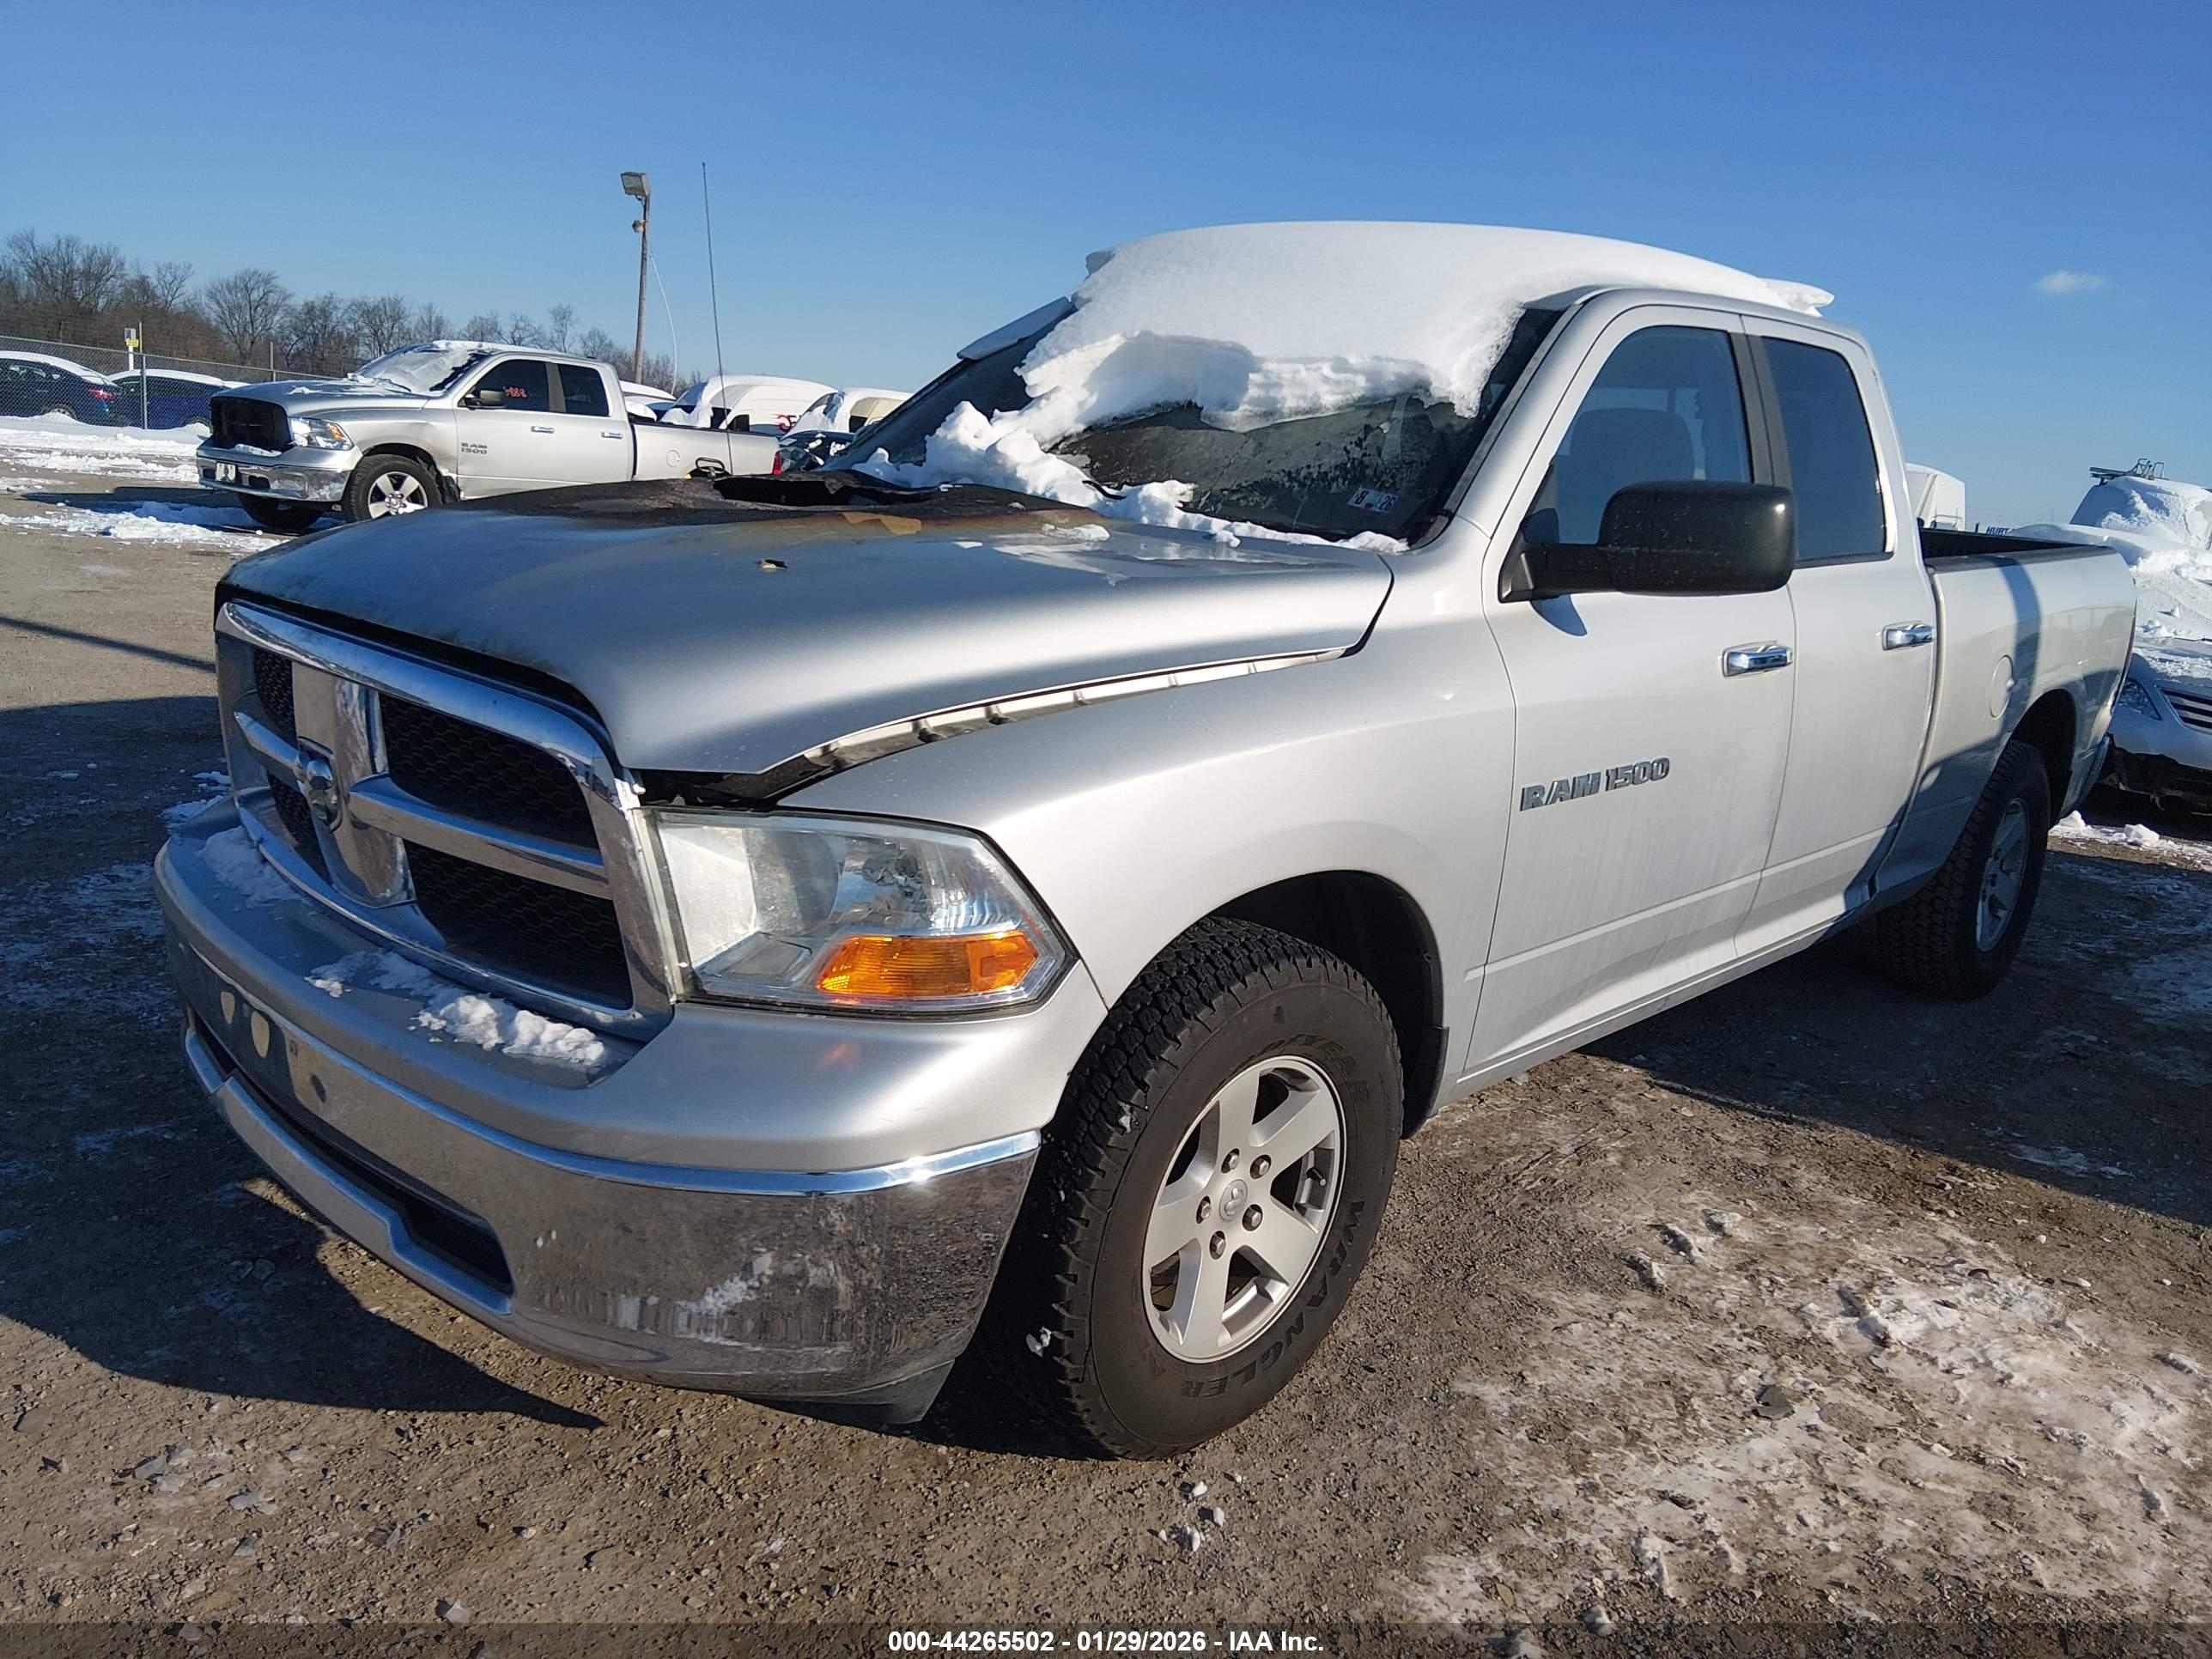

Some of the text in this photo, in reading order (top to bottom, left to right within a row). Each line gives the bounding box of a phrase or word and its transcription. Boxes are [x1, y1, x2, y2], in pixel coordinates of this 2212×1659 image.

[1520, 757, 1670, 811] RAM 1500
[1177, 1200, 1365, 1399] WRANGLER
